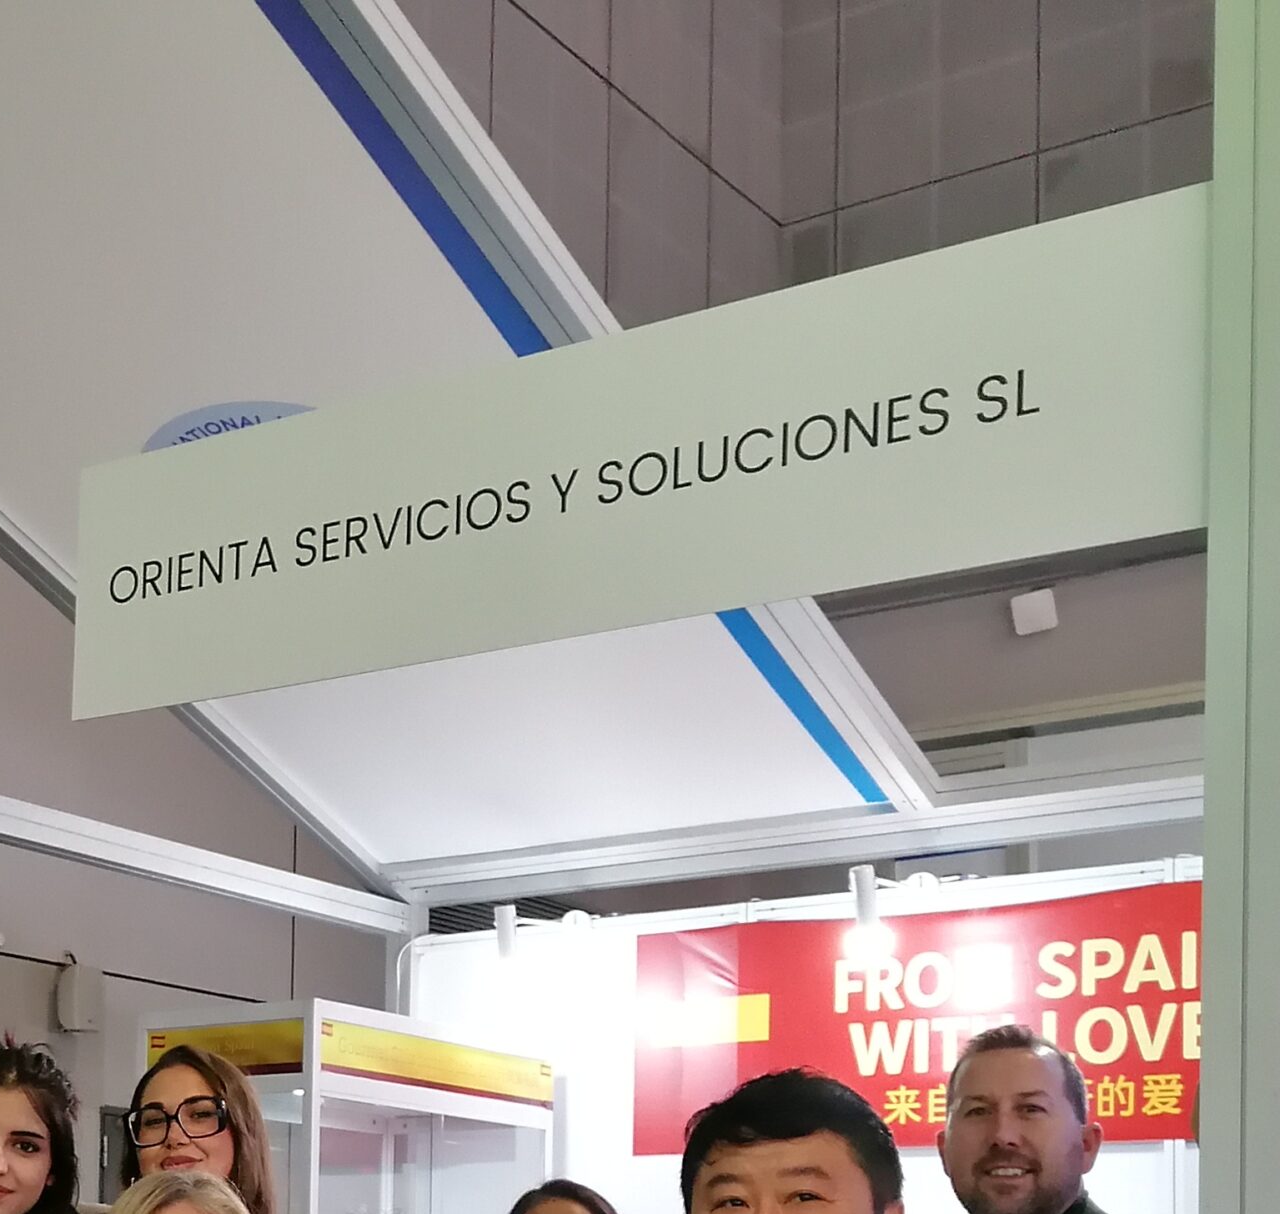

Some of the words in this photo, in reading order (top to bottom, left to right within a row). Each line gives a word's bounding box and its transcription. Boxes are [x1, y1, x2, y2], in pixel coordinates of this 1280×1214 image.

[109, 536, 277, 605] ORIENTA
[295, 480, 531, 568] SERVICIOS
[551, 470, 579, 513] Y
[596, 388, 948, 504] SOLUCIONES
[975, 370, 1041, 426] SL
[834, 948, 1014, 1013] FRO
[1035, 930, 1197, 1000] SPAI
[883, 1072, 1184, 1126] 来自的爱
